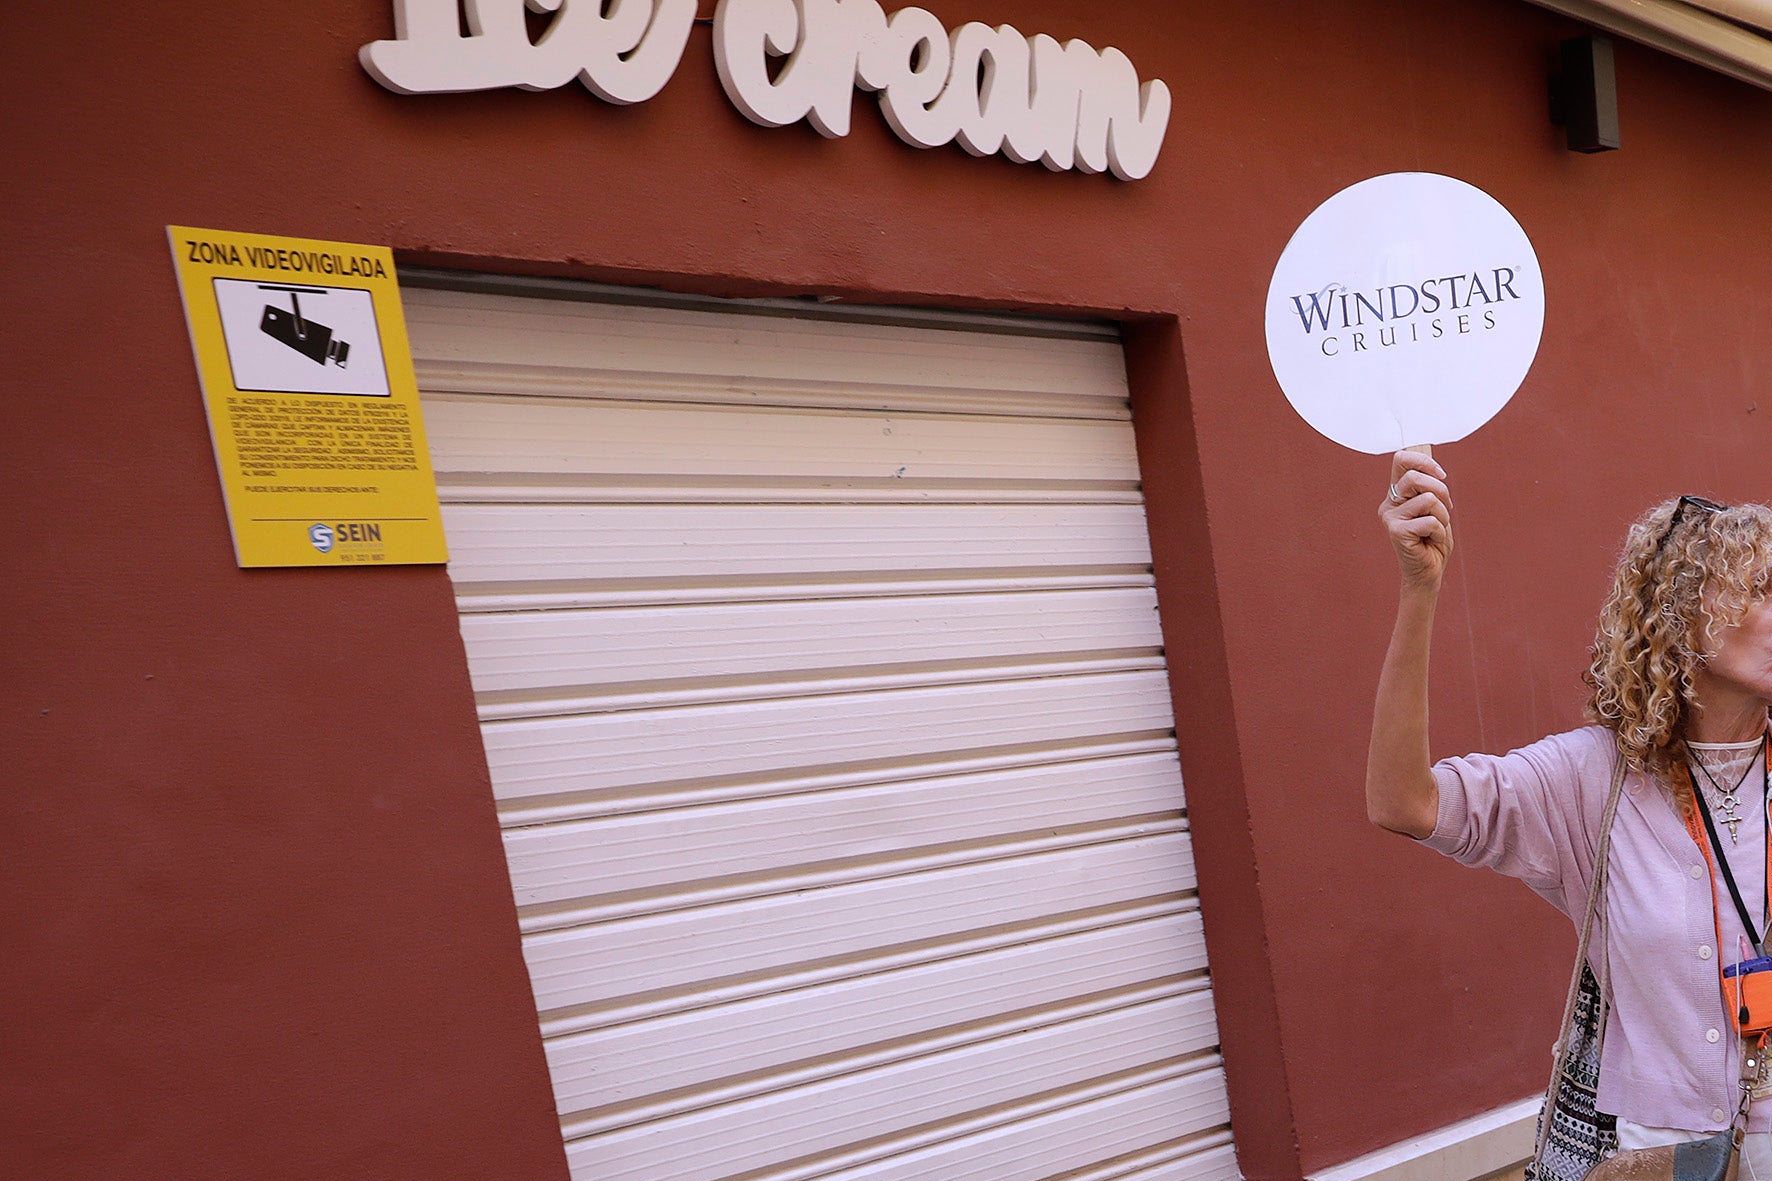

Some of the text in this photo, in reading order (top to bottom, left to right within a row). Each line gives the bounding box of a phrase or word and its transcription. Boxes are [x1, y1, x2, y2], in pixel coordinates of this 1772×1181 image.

[186, 241, 388, 279] ZONA VIDEOVIGILADA
[1290, 267, 1521, 334] WINDSTAR
[1321, 310, 1496, 356] CRUISES
[336, 523, 382, 542] SEIN
